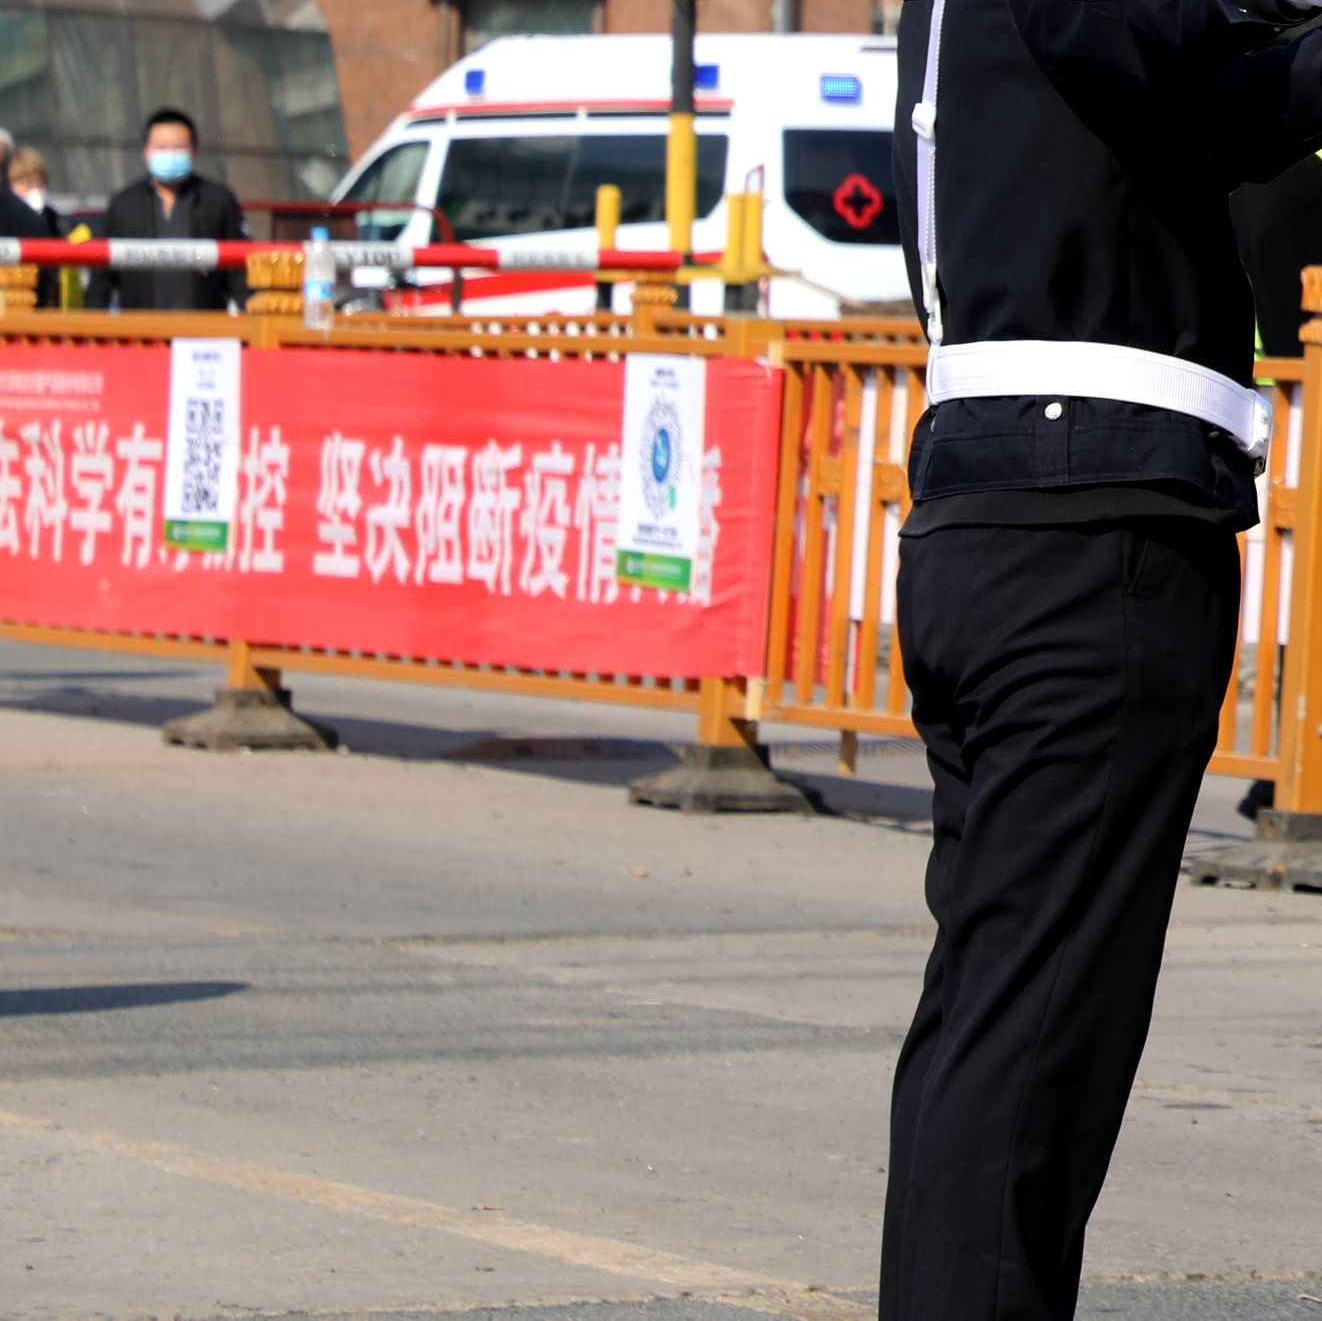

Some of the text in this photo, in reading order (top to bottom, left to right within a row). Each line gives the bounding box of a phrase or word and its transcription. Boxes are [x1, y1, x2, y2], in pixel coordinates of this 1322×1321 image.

[0, 419, 722, 606] 科学有控 坚决阻断疫情
